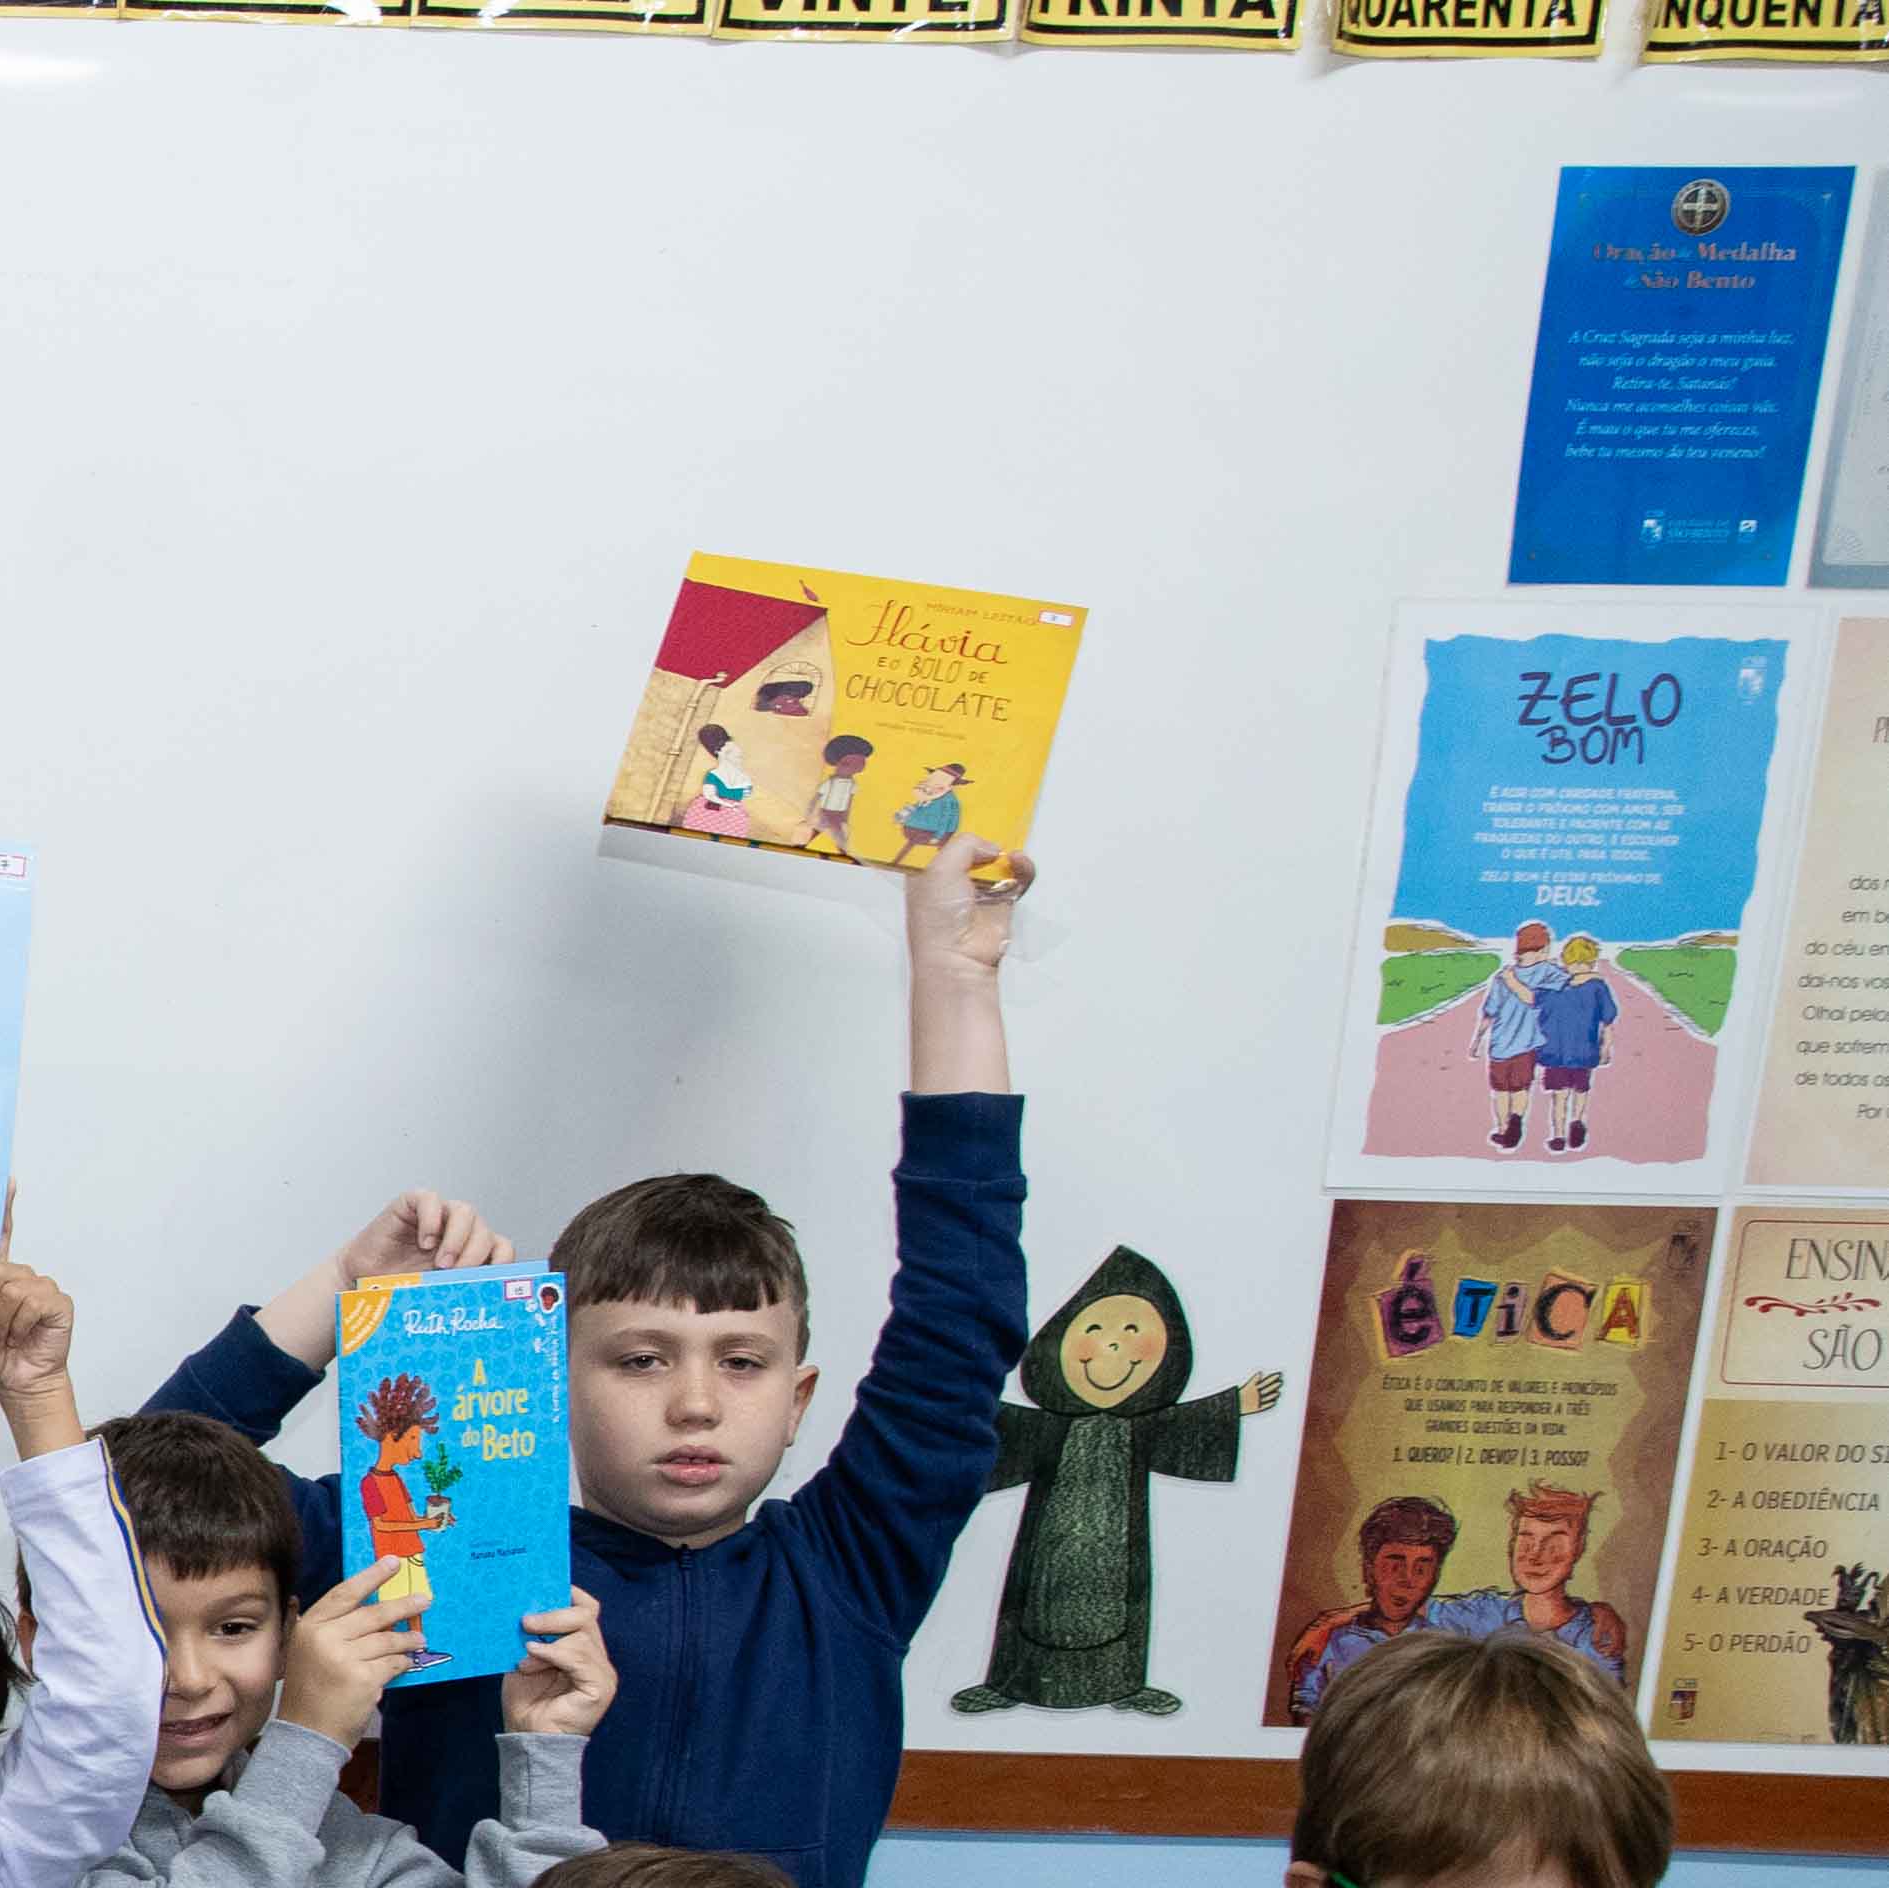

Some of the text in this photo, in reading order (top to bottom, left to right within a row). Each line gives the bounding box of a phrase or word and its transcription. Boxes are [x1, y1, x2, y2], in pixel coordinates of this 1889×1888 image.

[910, 656, 960, 684] BOLO
[845, 673, 1012, 721] CHOCOLATE
[1517, 672, 1681, 728] ZELO
[1537, 724, 1645, 765] BOM
[1535, 885, 1601, 906] DEUS.
[1833, 940, 1864, 955] céu
[1822, 1072, 1869, 1086] todos
[403, 1309, 449, 1337] Ruth
[450, 1307, 503, 1336] Rocha
[1803, 1324, 1883, 1372] SÃO
[472, 1359, 487, 1386] A
[453, 1386, 528, 1422] árvore
[483, 1424, 535, 1461] Beto
[1764, 1442, 1865, 1462] VALOR DO
[1752, 1485, 1879, 1511] OBEDIÊNCIA
[1743, 1535, 1827, 1563] ORAÇÃO
[1736, 1587, 1829, 1606] VERDADE
[1730, 1630, 1811, 1654] PERDÃO
